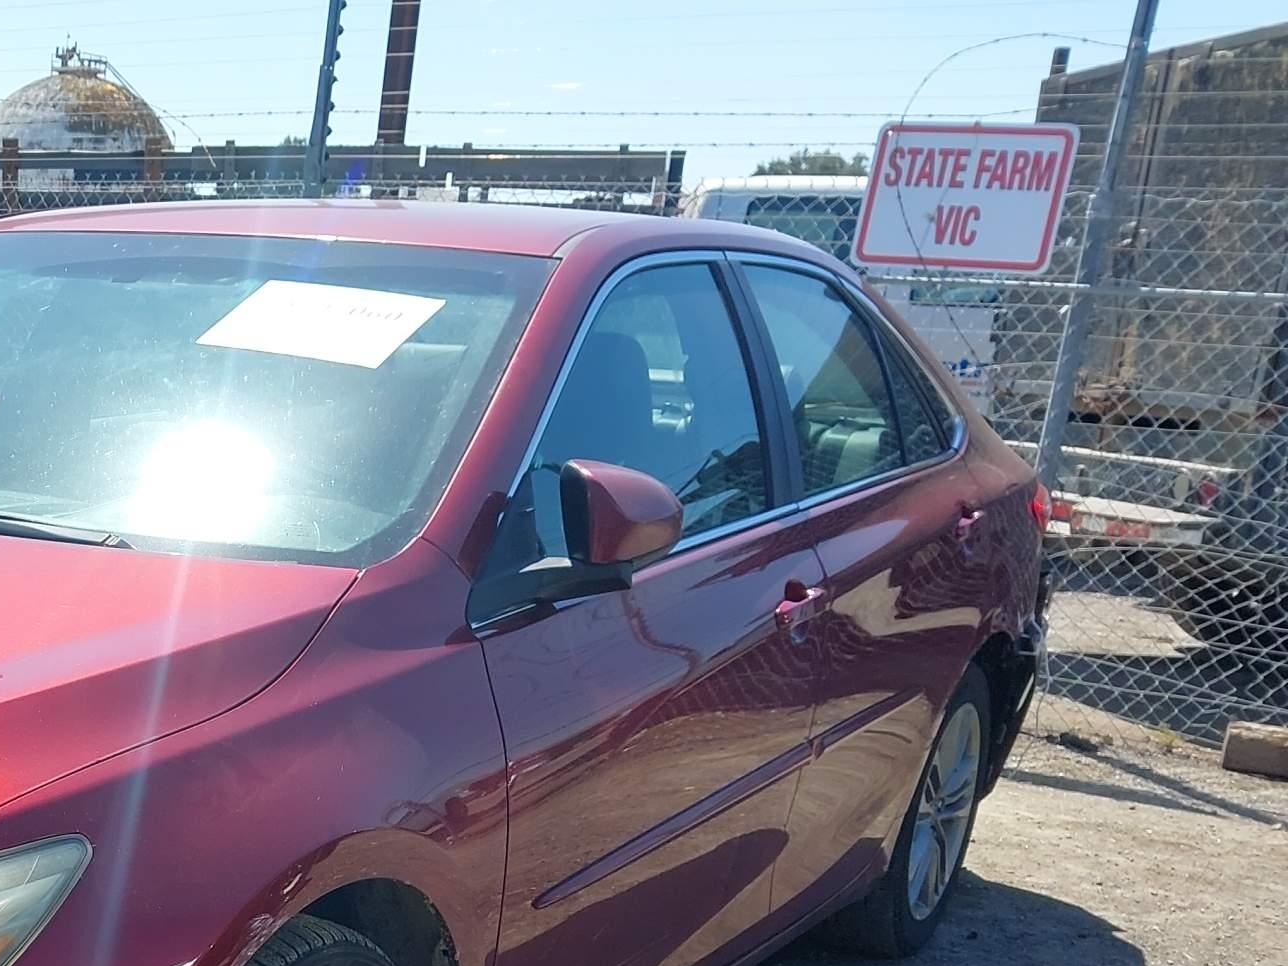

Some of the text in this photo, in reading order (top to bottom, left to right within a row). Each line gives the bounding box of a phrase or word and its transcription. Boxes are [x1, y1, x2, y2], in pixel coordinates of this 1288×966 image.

[884, 146, 1059, 192] STATE FARM
[934, 204, 981, 247] VIC
